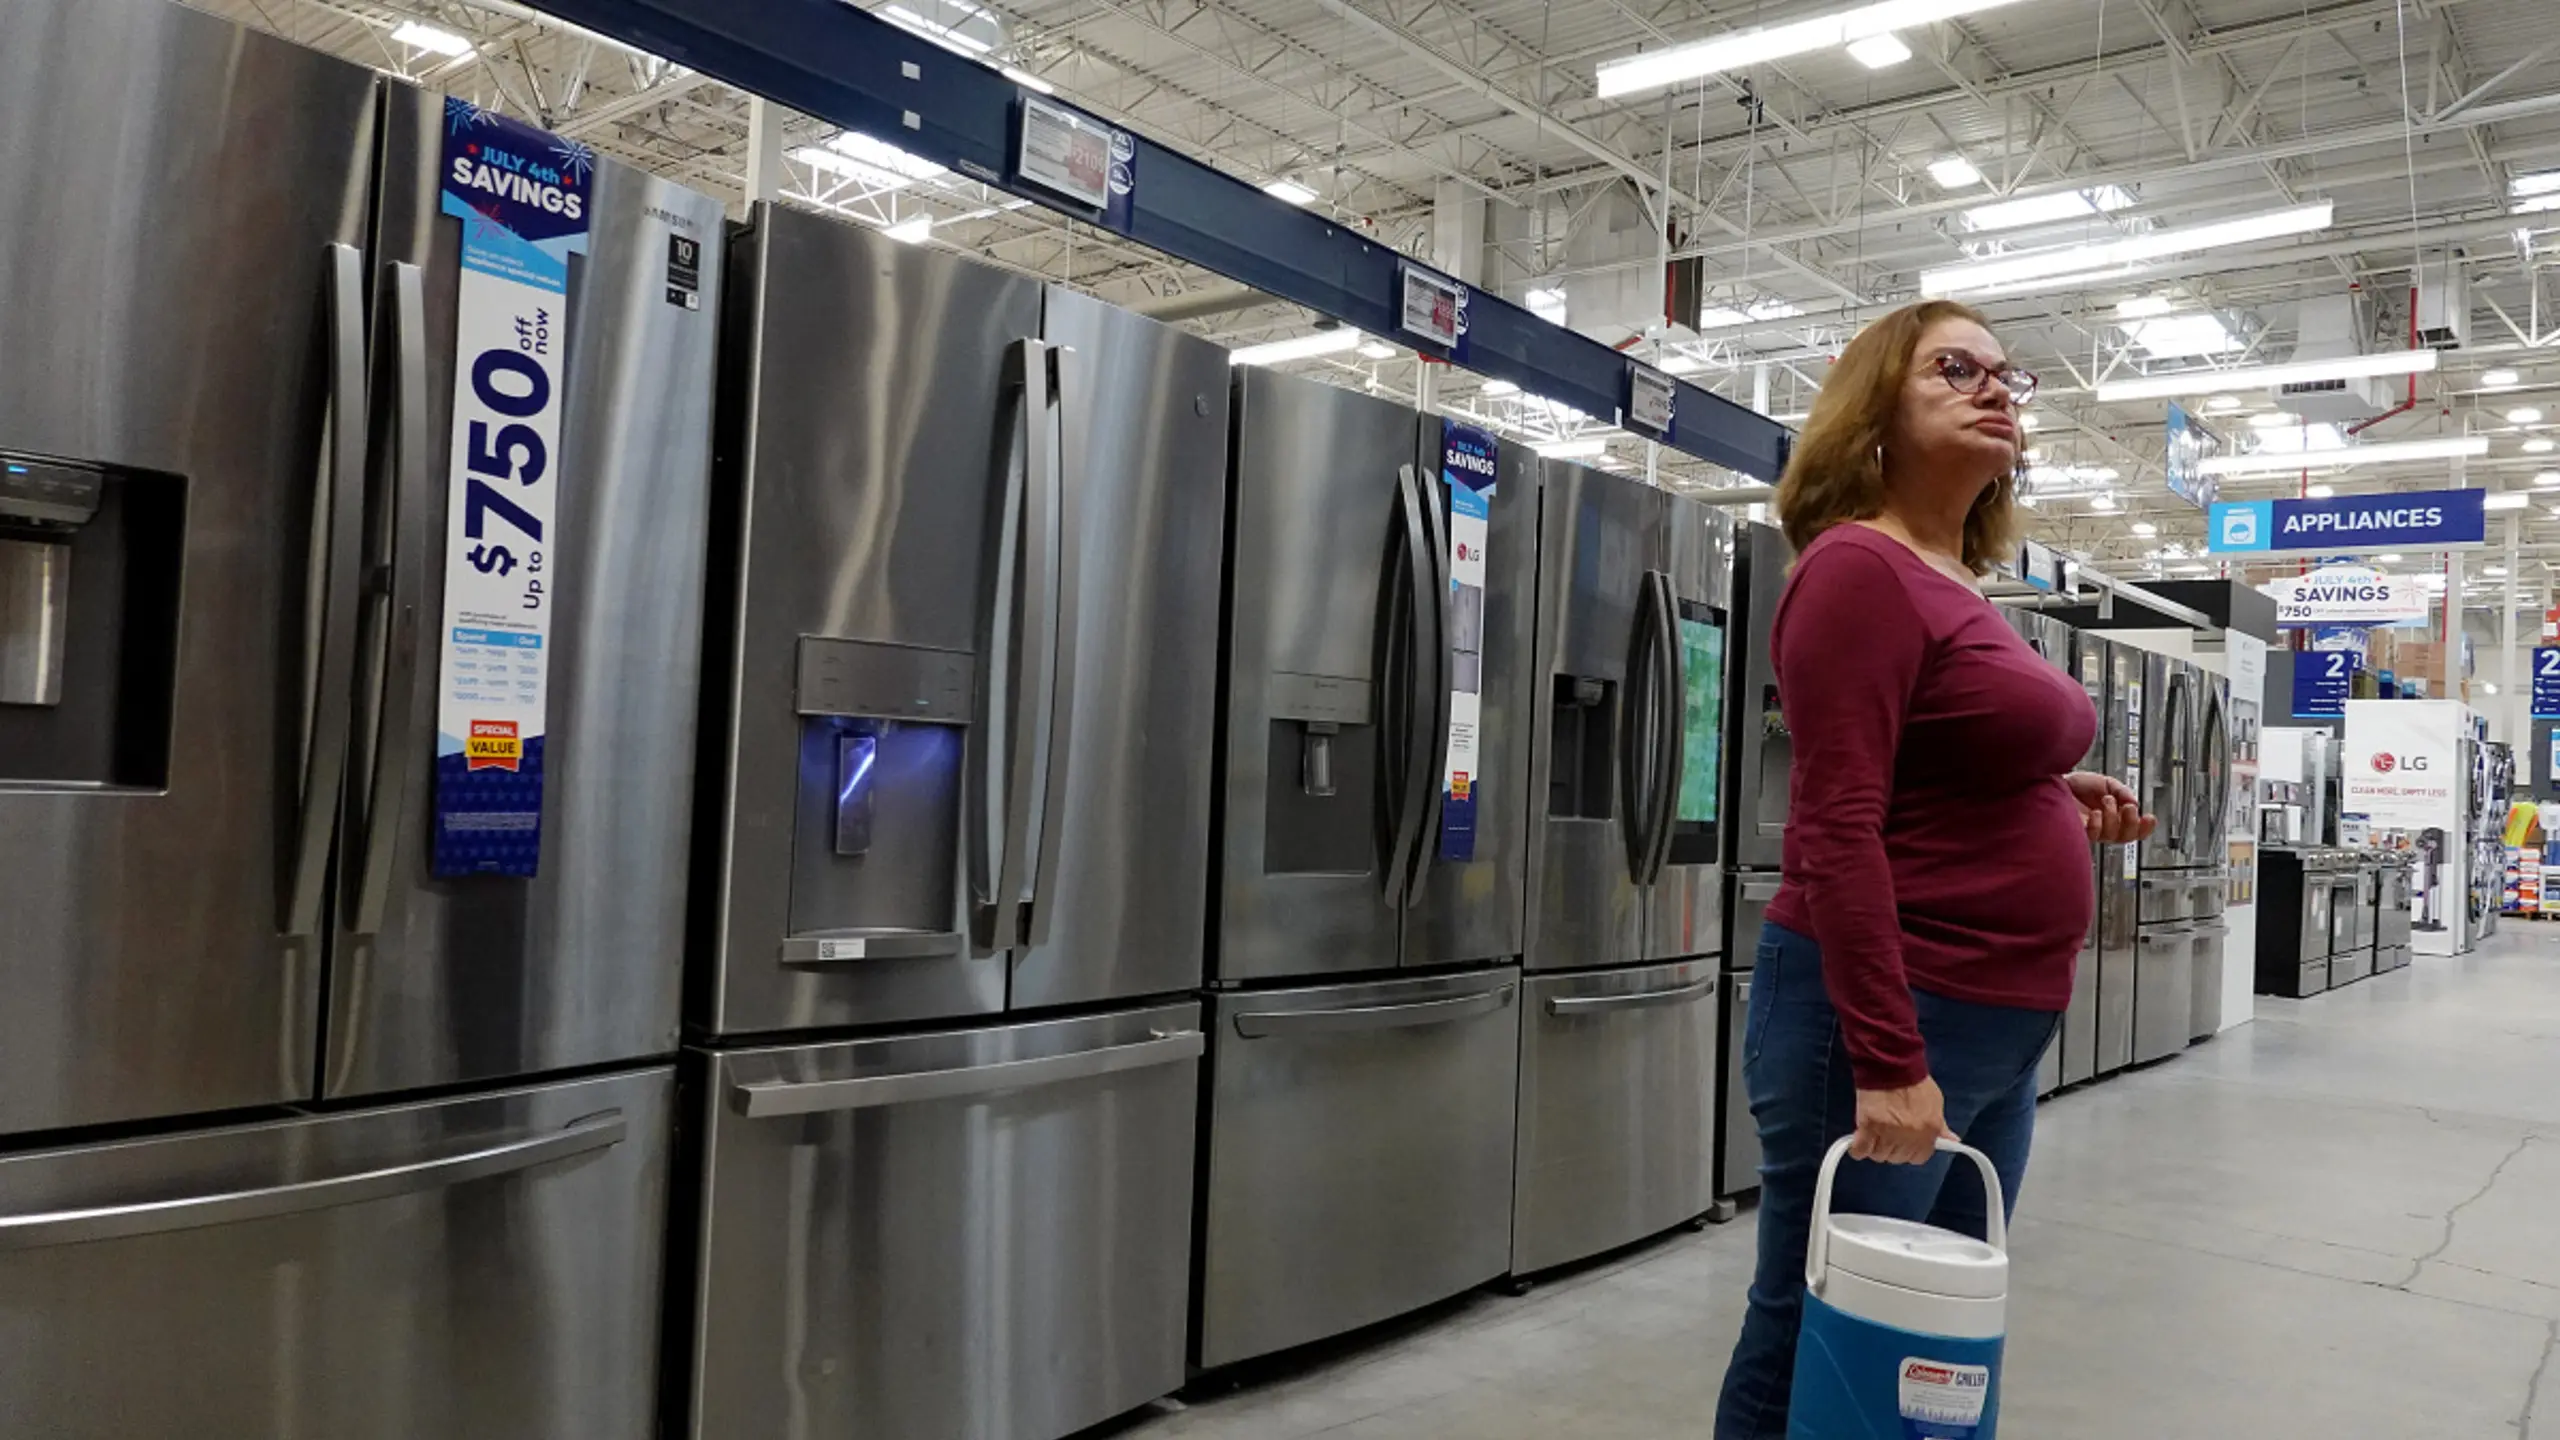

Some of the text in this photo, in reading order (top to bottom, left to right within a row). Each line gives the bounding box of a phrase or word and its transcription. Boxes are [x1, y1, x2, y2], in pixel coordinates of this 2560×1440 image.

[480, 146, 561, 186] JULY 4th
[452, 156, 583, 220] SAVINGS
[675, 239, 693, 260] 10
[514, 316, 533, 352] off
[534, 307, 551, 355] now
[465, 347, 551, 577] $750
[1446, 448, 1495, 477] SAVINGS
[2282, 507, 2443, 533] APPLIANCES
[523, 550, 546, 609] Up to
[2313, 575, 2372, 585] JULY 4th
[2293, 585, 2390, 603] SAVINGS
[2278, 605, 2312, 618] $750
[2325, 652, 2346, 678] 2
[2352, 653, 2361, 669] 2
[2540, 649, 2560, 676] 2
[472, 723, 516, 738] SPECIAL
[470, 740, 517, 756] VALUE
[2400, 755, 2428, 771] LG
